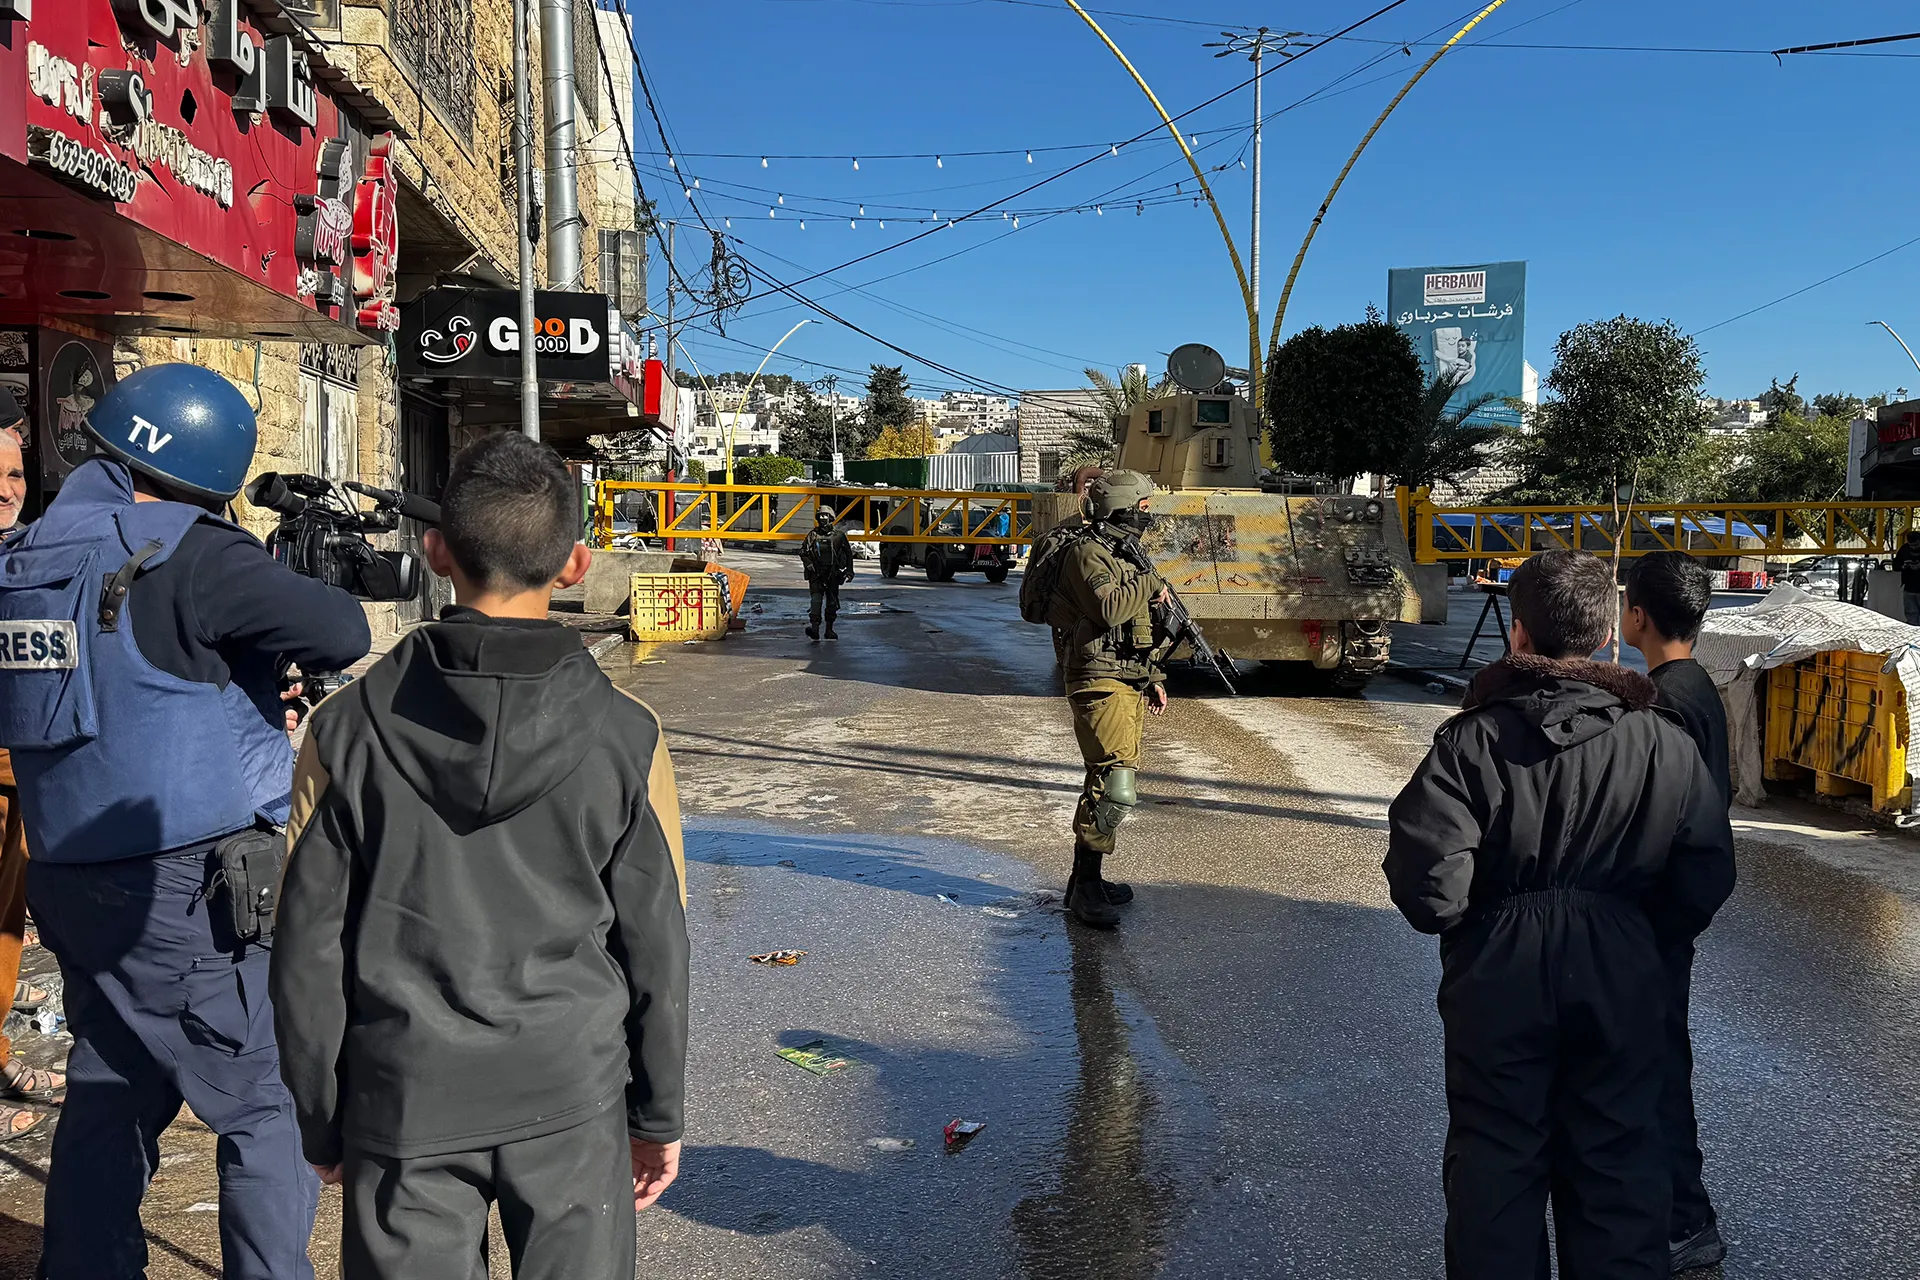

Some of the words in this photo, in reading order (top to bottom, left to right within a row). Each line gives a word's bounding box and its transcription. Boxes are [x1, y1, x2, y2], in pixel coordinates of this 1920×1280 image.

[1426, 272, 1484, 290] HERBAWI
[1396, 308, 1454, 325] حرباوي
[1457, 303, 1513, 319] فرشات
[534, 336, 569, 353] OOD
[127, 414, 173, 454] TV
[657, 588, 703, 632] 39
[0, 630, 67, 661] RESS
